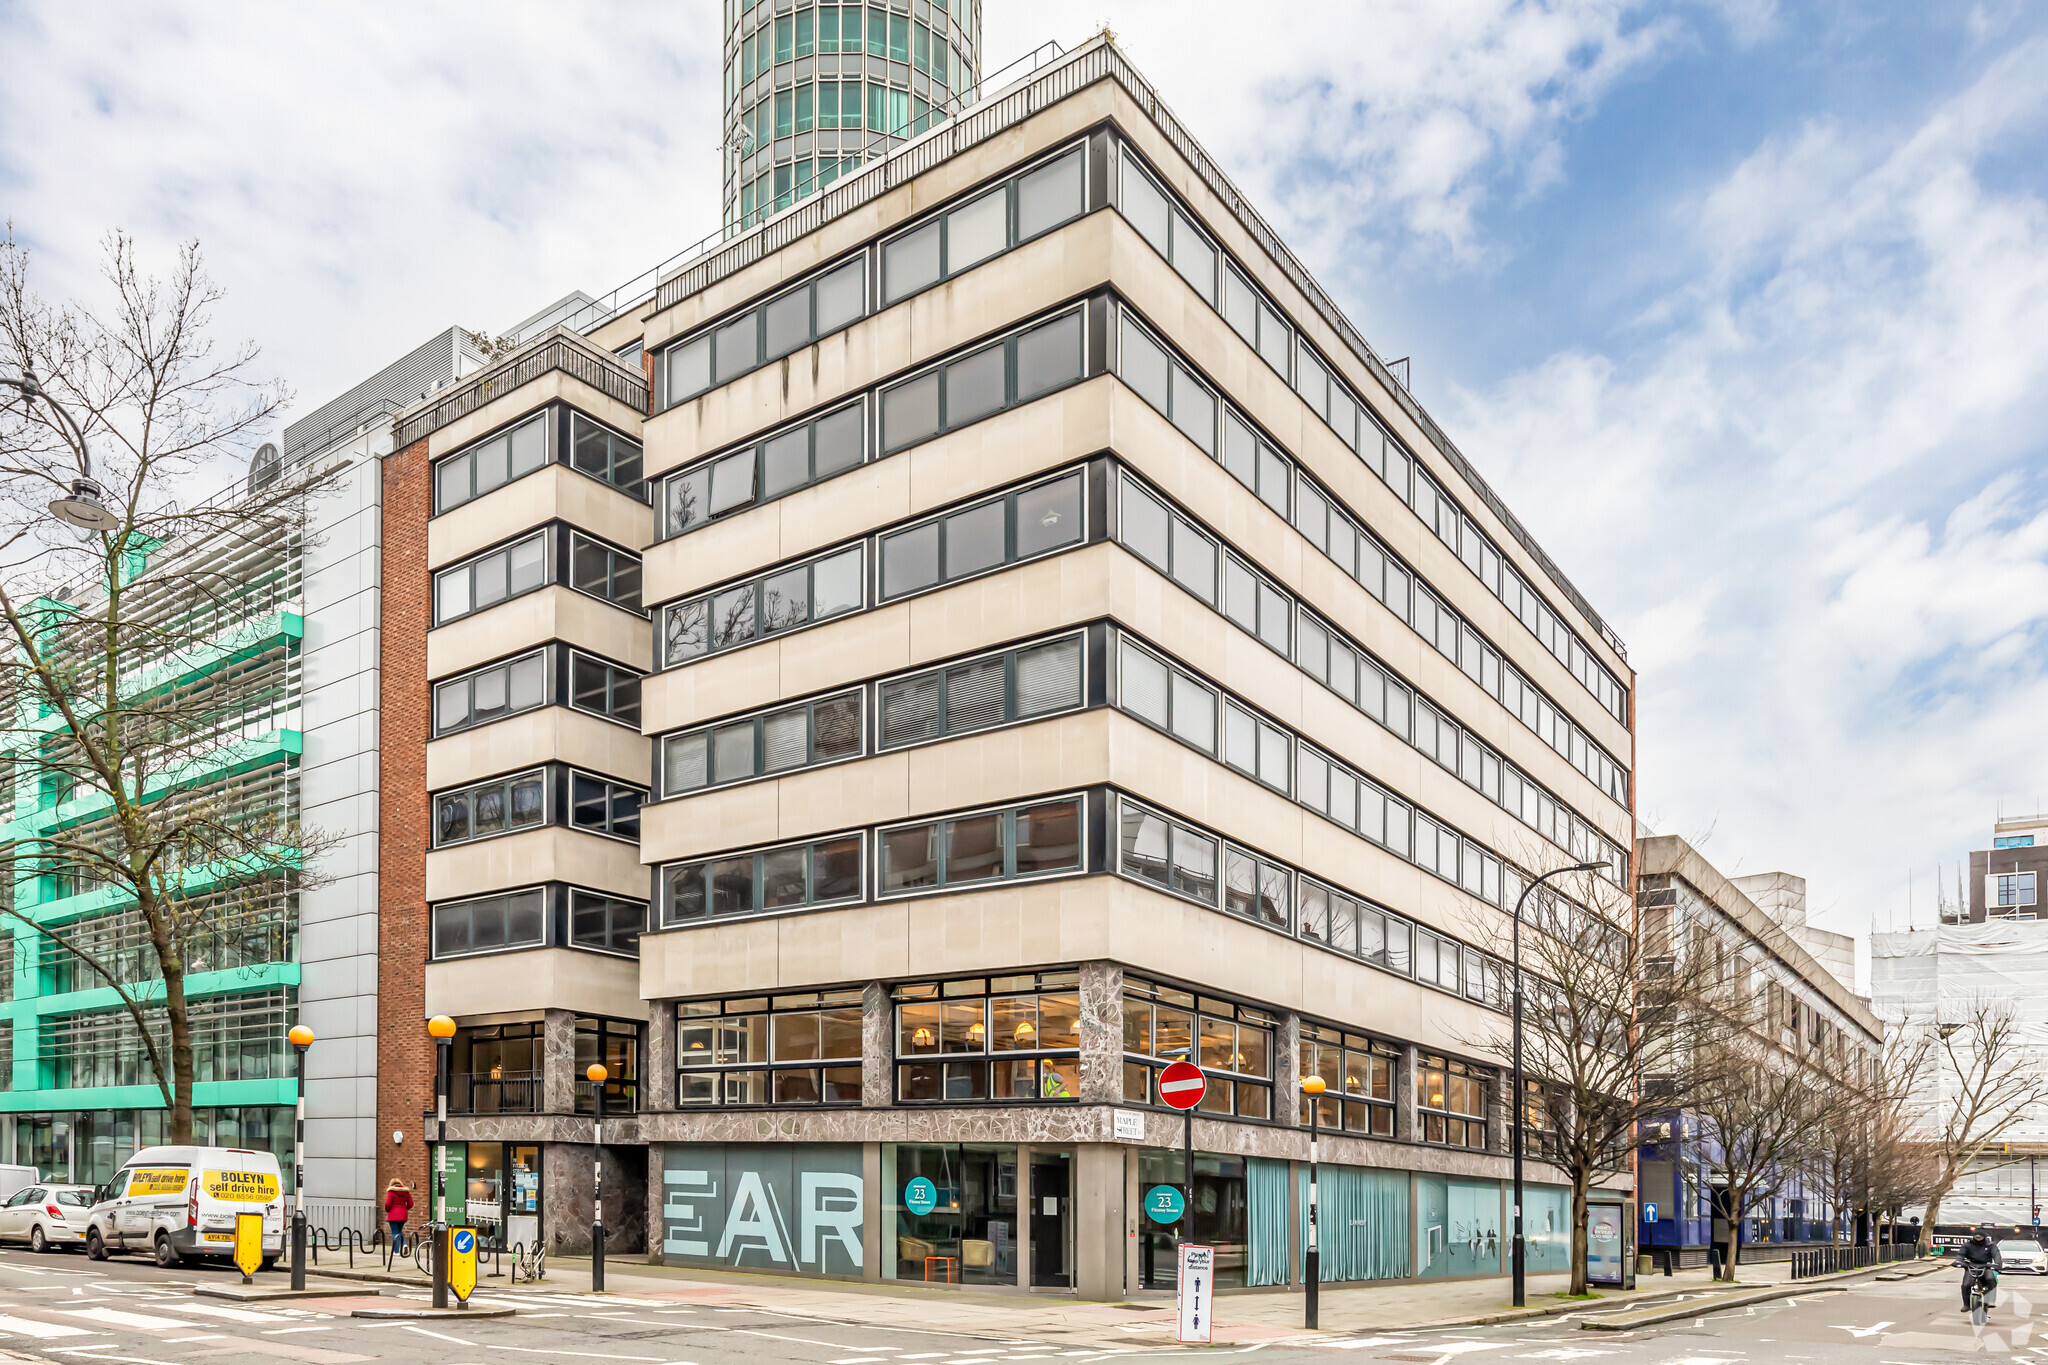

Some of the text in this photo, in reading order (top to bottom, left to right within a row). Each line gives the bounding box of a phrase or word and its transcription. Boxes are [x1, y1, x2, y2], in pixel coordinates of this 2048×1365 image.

[1116, 1116, 1138, 1126] MAPLE
[1116, 1126, 1138, 1136] STREET
[221, 1172, 264, 1184] BOLEYN
[209, 1183, 275, 1195] self drive hire
[914, 1189, 926, 1199] 23
[1157, 1196, 1172, 1208] 23
[663, 1169, 864, 1274] EAR
